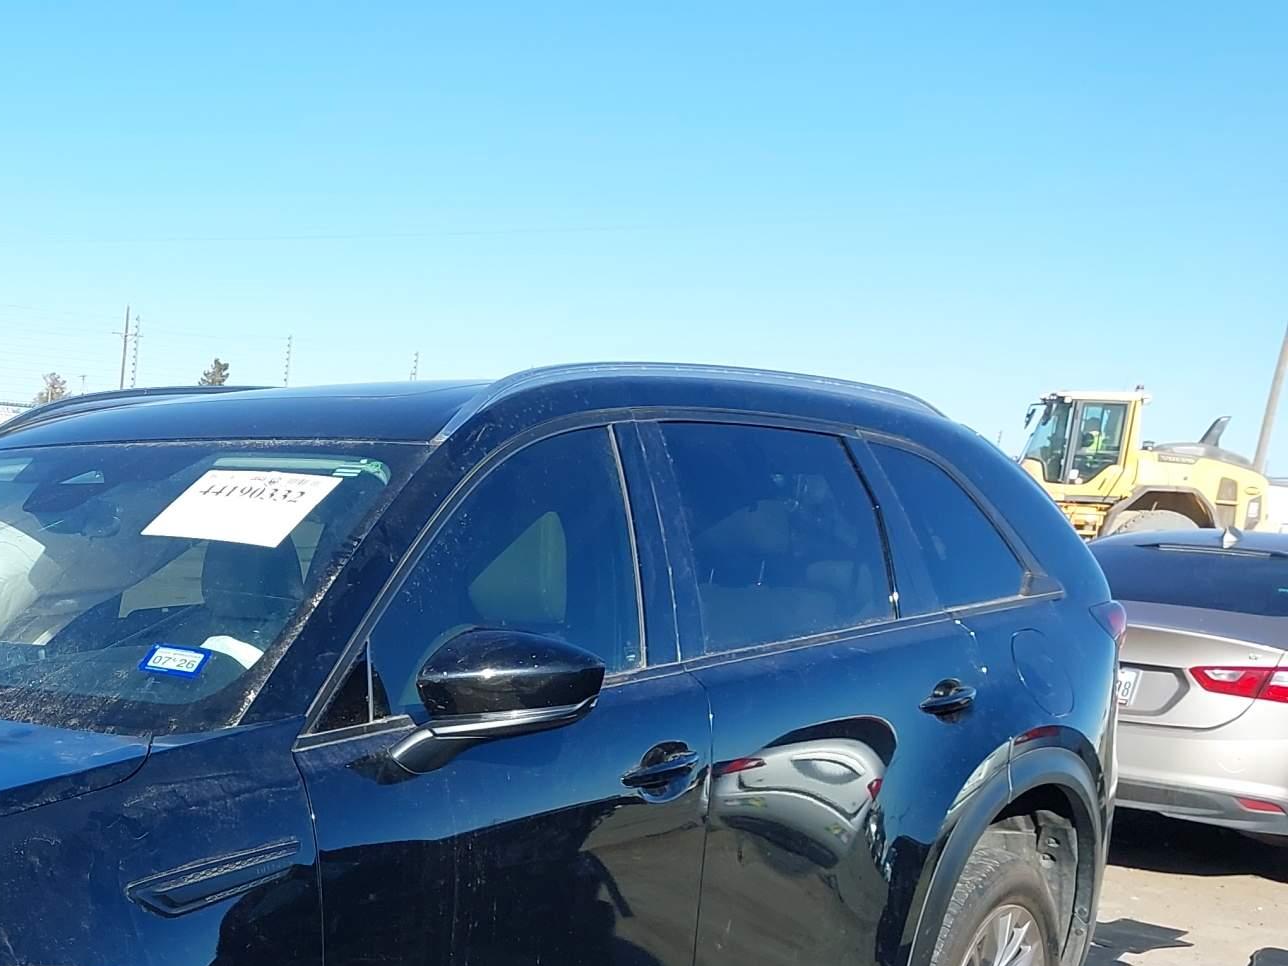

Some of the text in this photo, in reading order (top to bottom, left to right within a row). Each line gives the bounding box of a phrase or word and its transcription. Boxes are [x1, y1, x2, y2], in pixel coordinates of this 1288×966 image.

[200, 484, 305, 503] 44190332
[152, 655, 197, 669] 07 26
